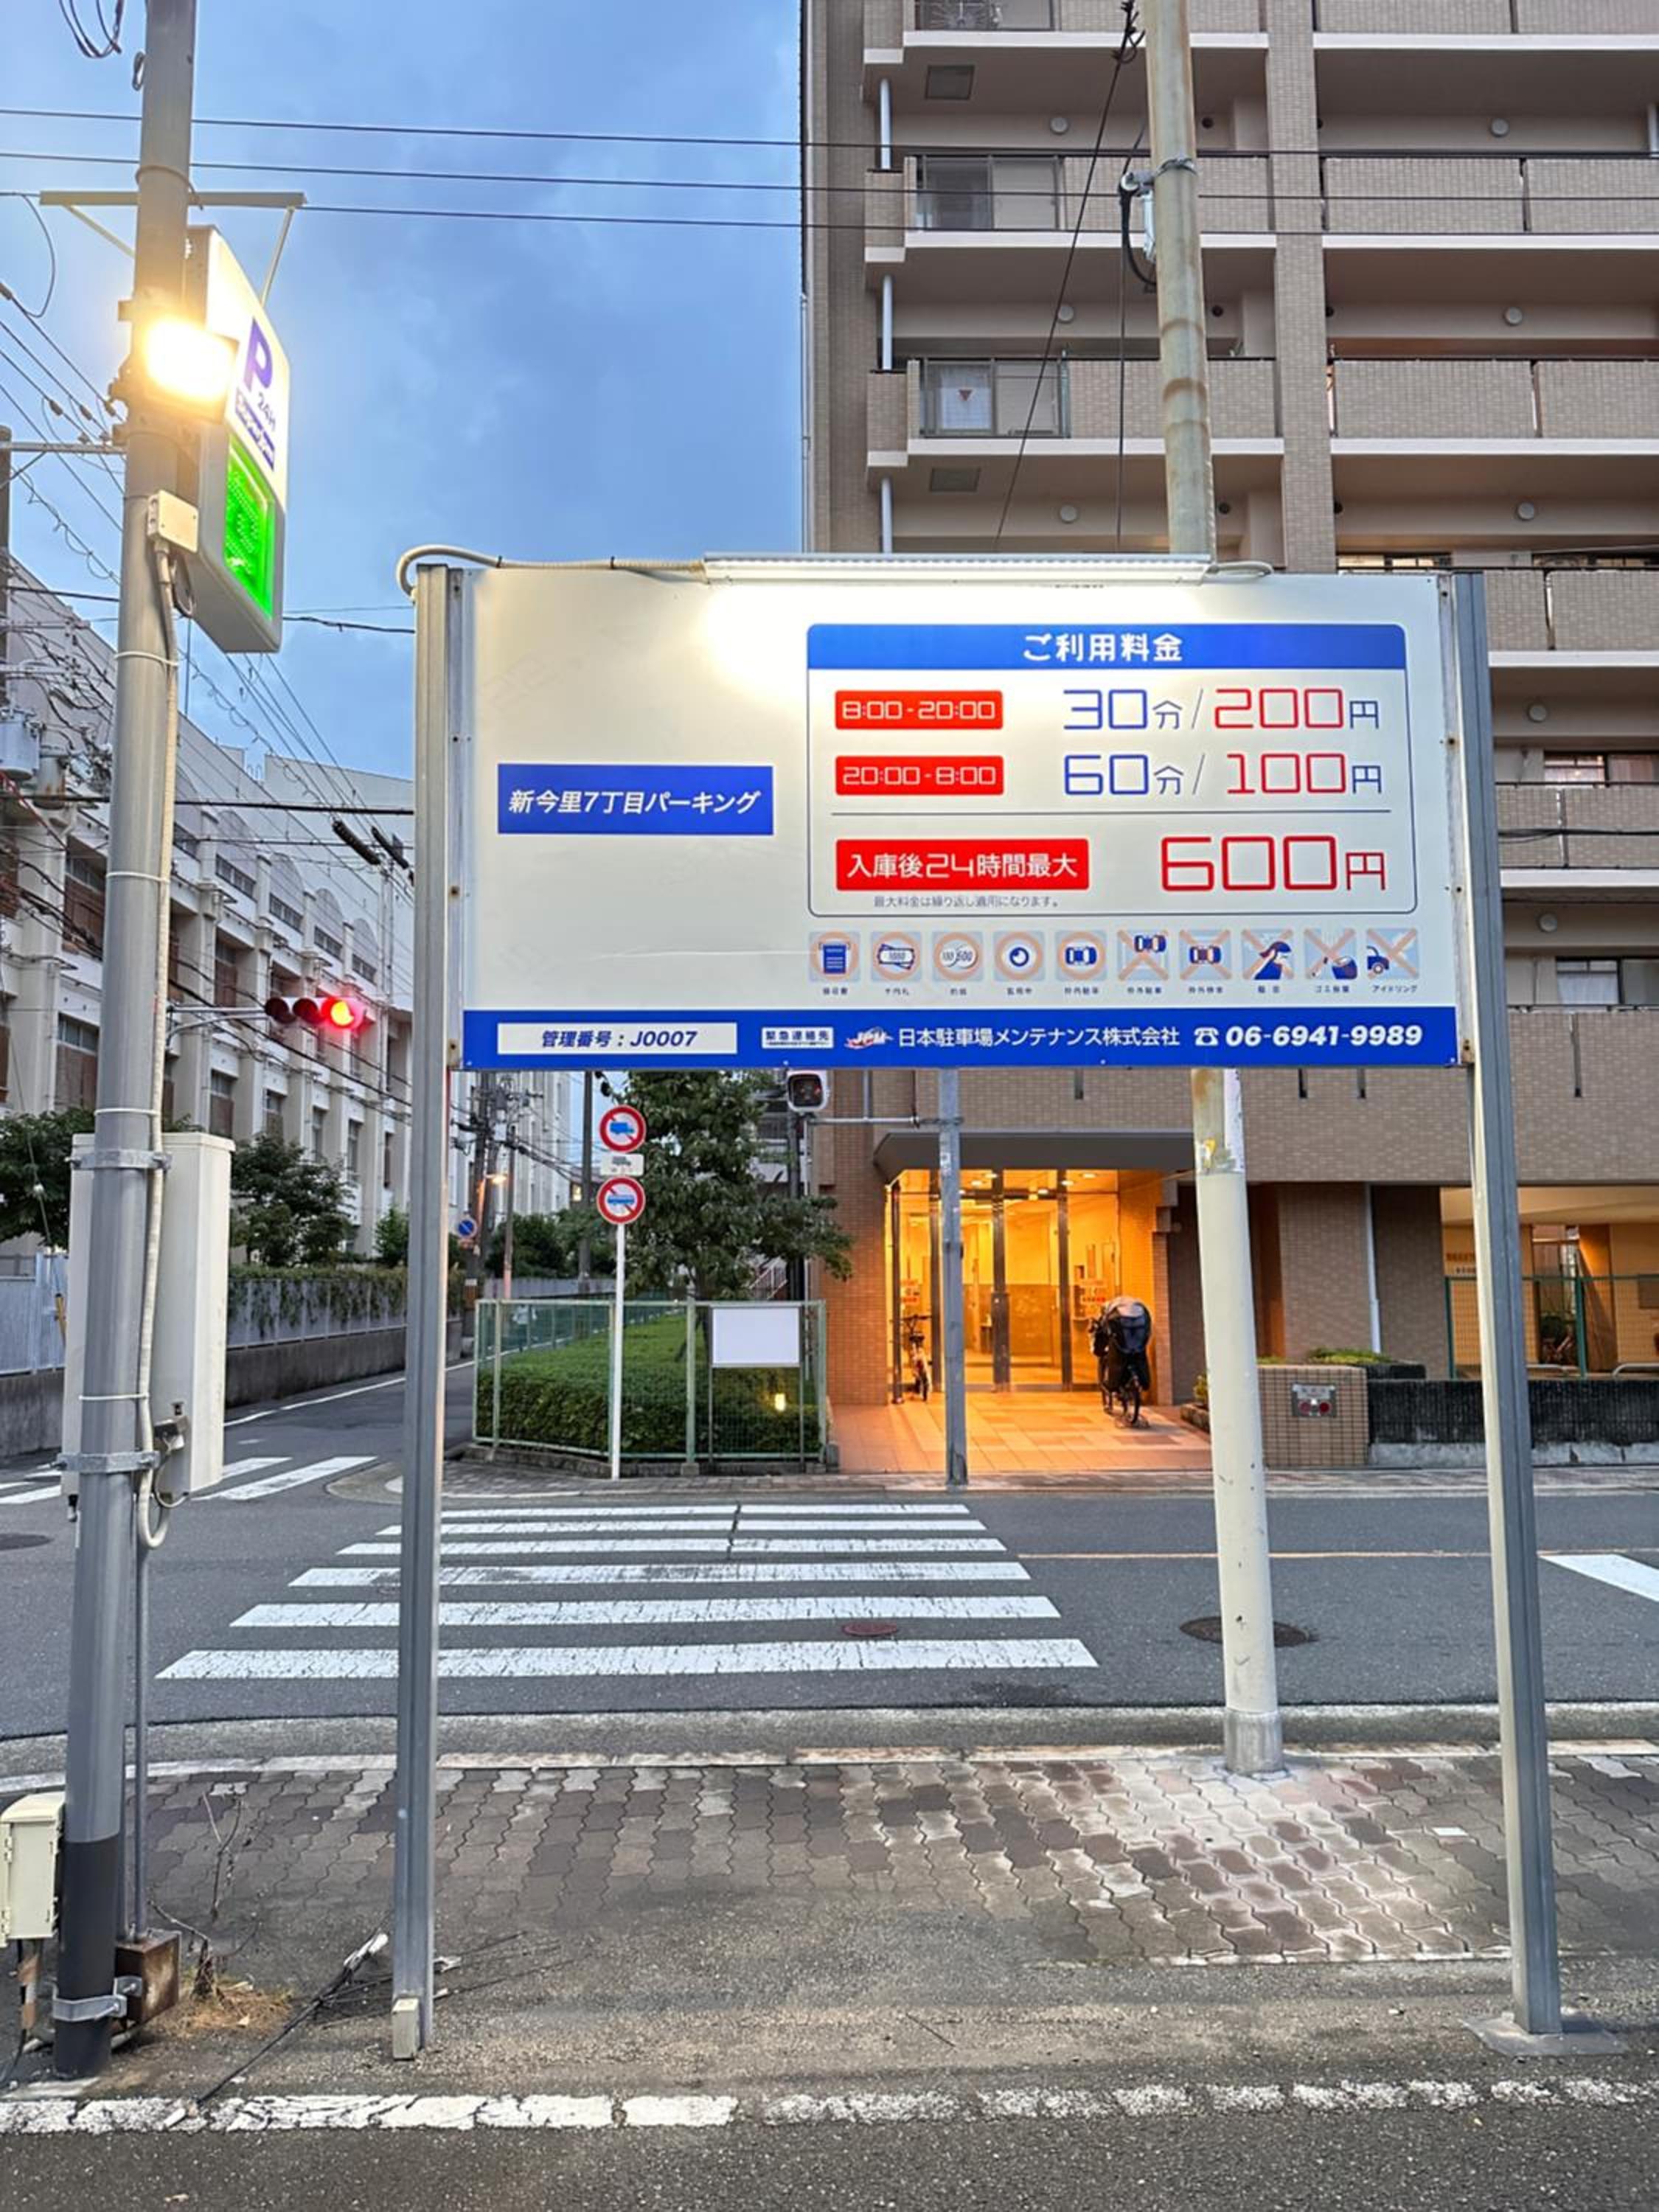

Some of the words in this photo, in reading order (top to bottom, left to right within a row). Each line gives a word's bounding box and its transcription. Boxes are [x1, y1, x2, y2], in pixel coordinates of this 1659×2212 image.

[243, 316, 273, 392] P
[1023, 633, 1182, 662] ご利用料金
[508, 790, 762, 814] 新今里7丁目パーキング
[847, 853, 1077, 878] 入庫後24時間最大
[1161, 835, 1386, 891] 600円
[899, 1027, 1180, 1047] 日本駐車場メンテナンス株式会社
[1226, 1026, 1422, 1046] 06-6941-9989
